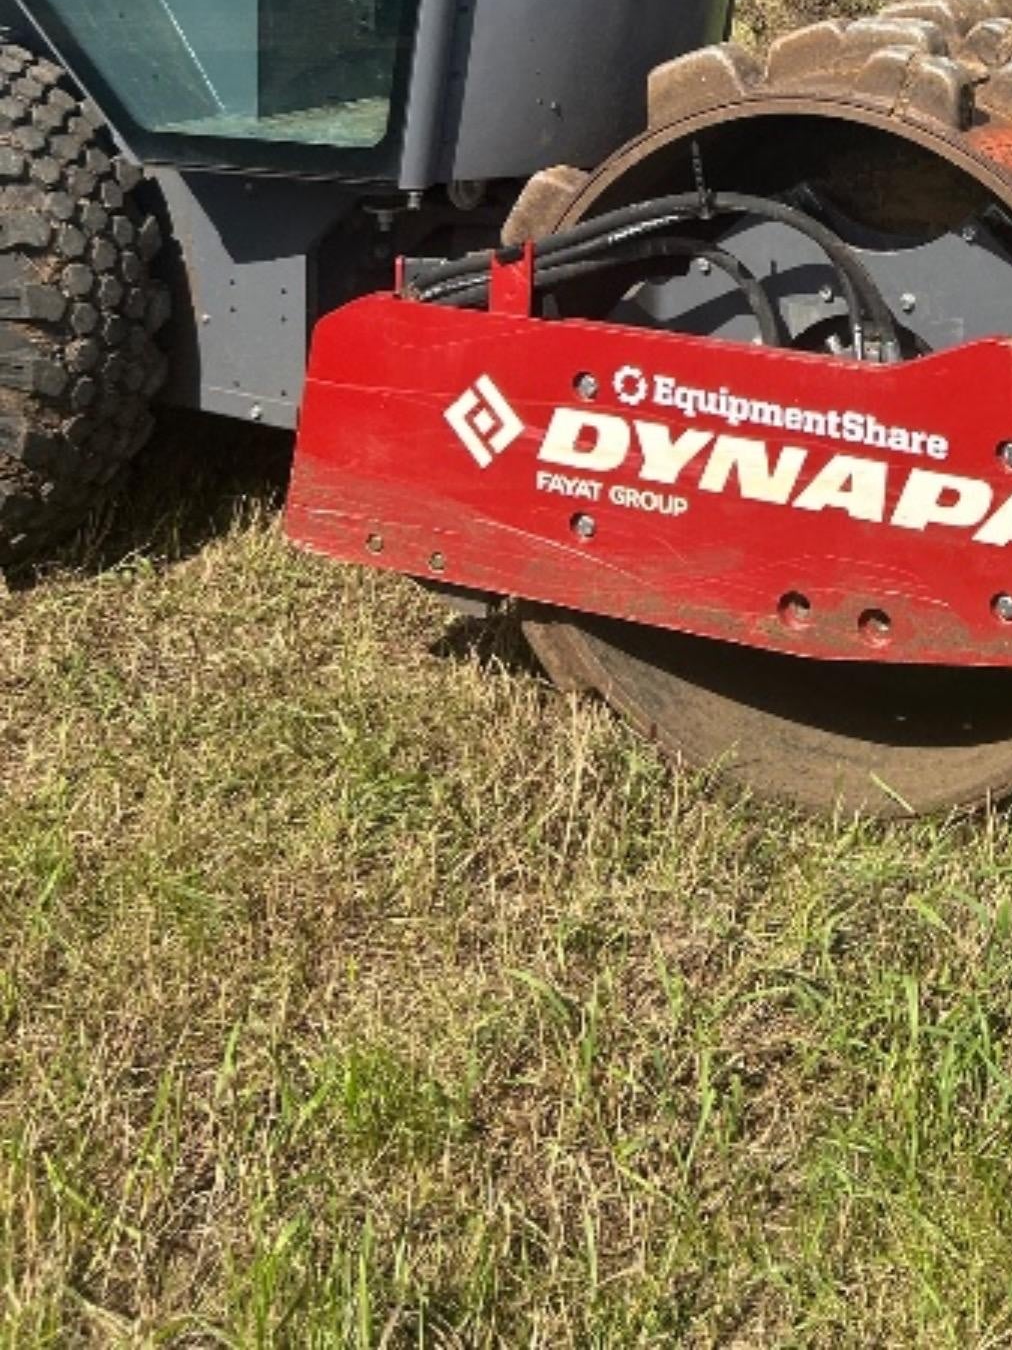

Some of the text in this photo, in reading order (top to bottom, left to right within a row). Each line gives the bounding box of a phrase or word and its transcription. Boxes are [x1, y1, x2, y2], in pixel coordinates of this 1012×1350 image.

[652, 374, 949, 460] EquipmentShare
[536, 471, 689, 517] FAYAT GROUP
